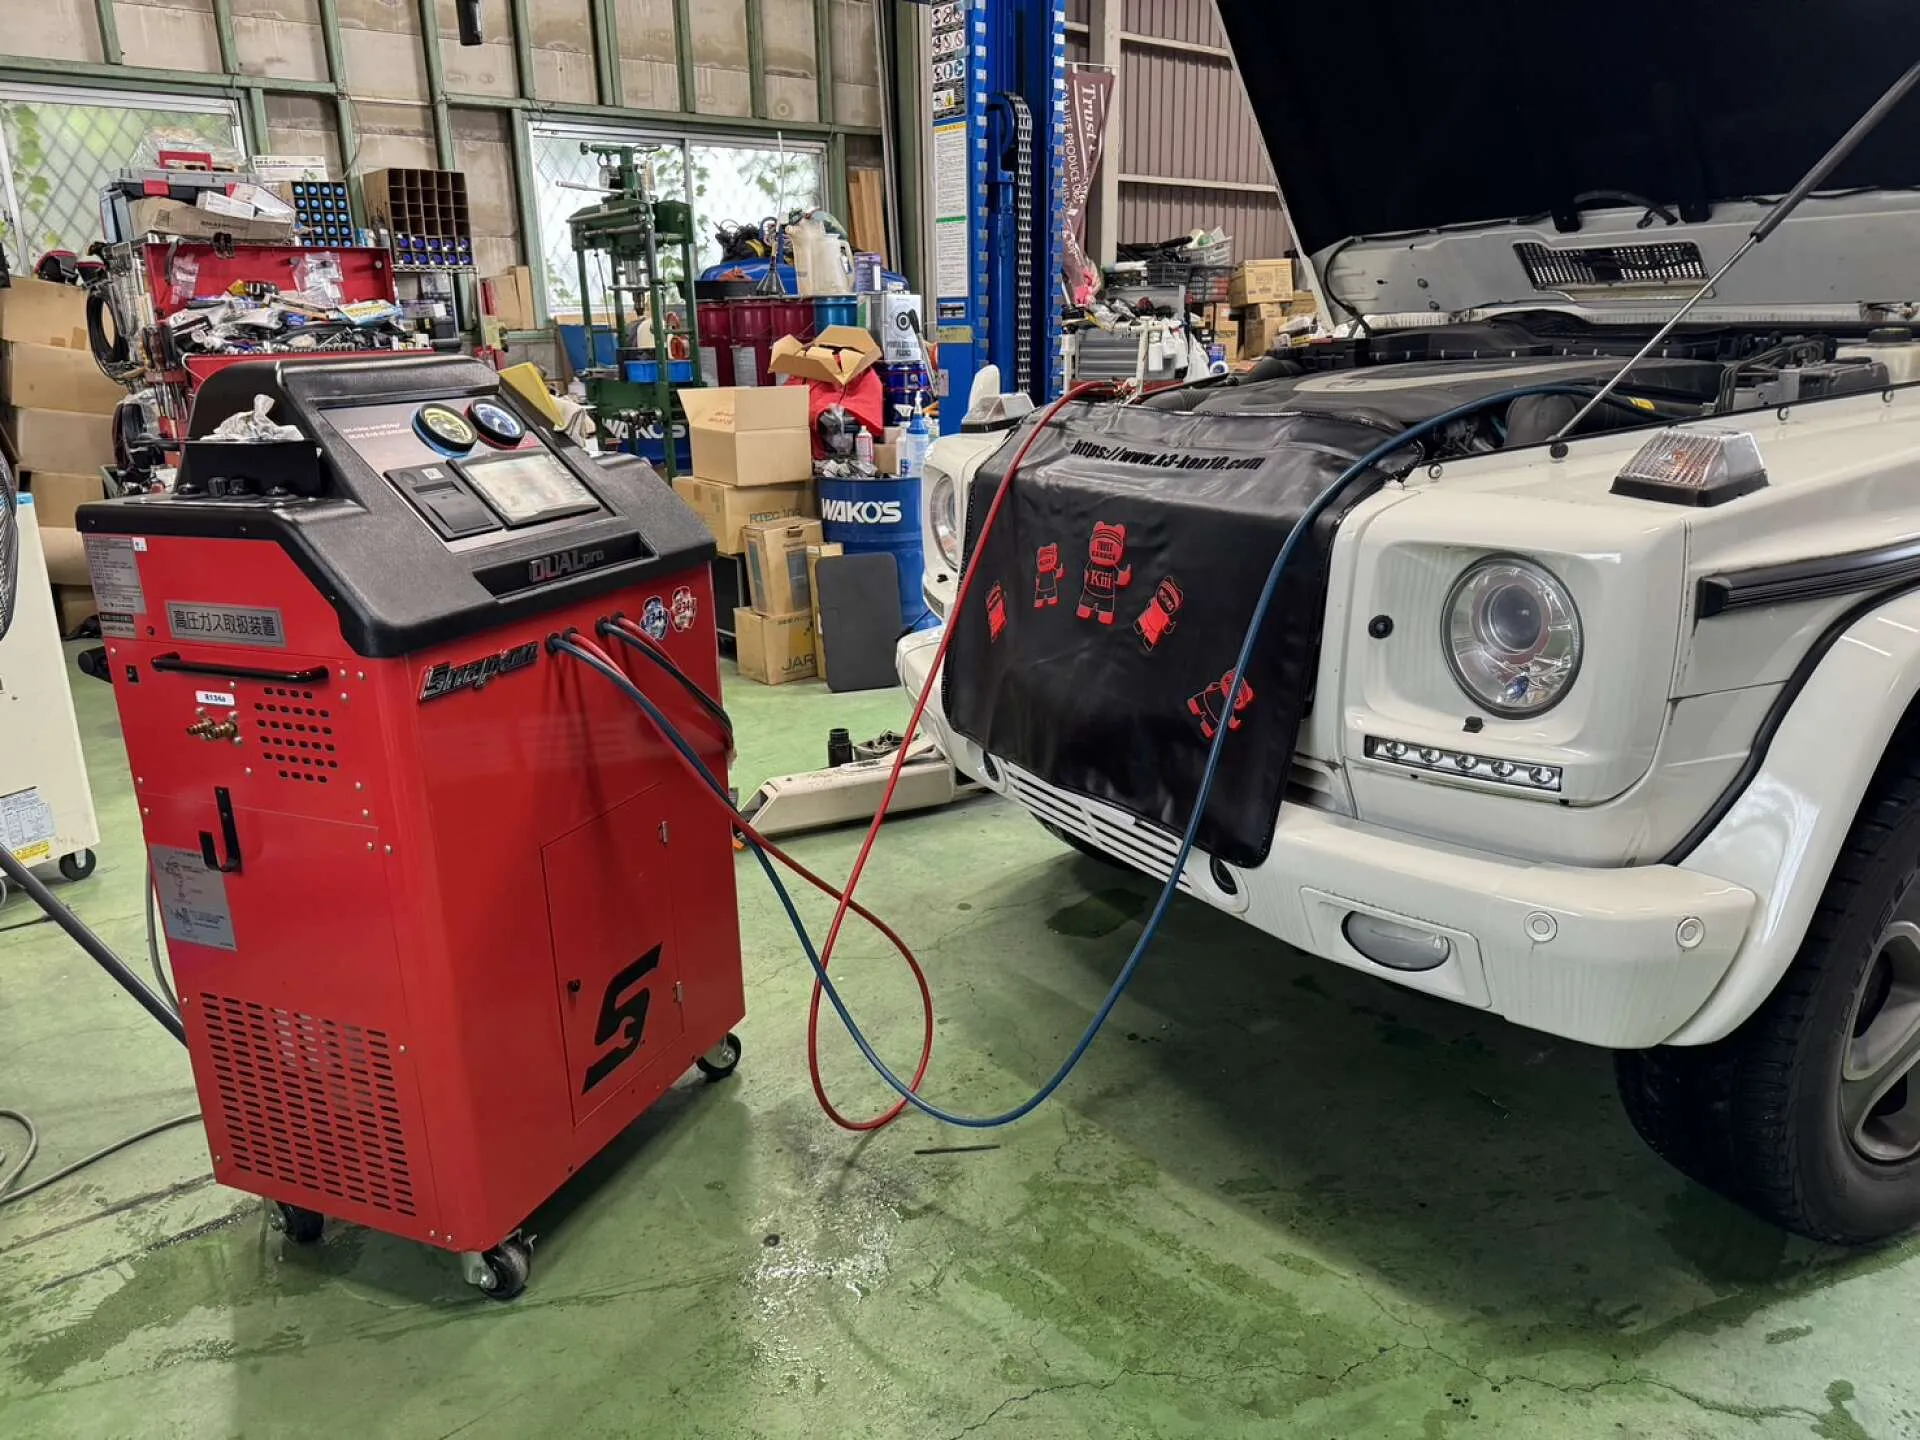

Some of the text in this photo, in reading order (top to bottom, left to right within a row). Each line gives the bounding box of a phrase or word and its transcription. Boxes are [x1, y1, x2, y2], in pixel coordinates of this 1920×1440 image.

[822, 498, 902, 524] WAKO'S
[174, 610, 276, 637] 高圧ガス取扱装置
